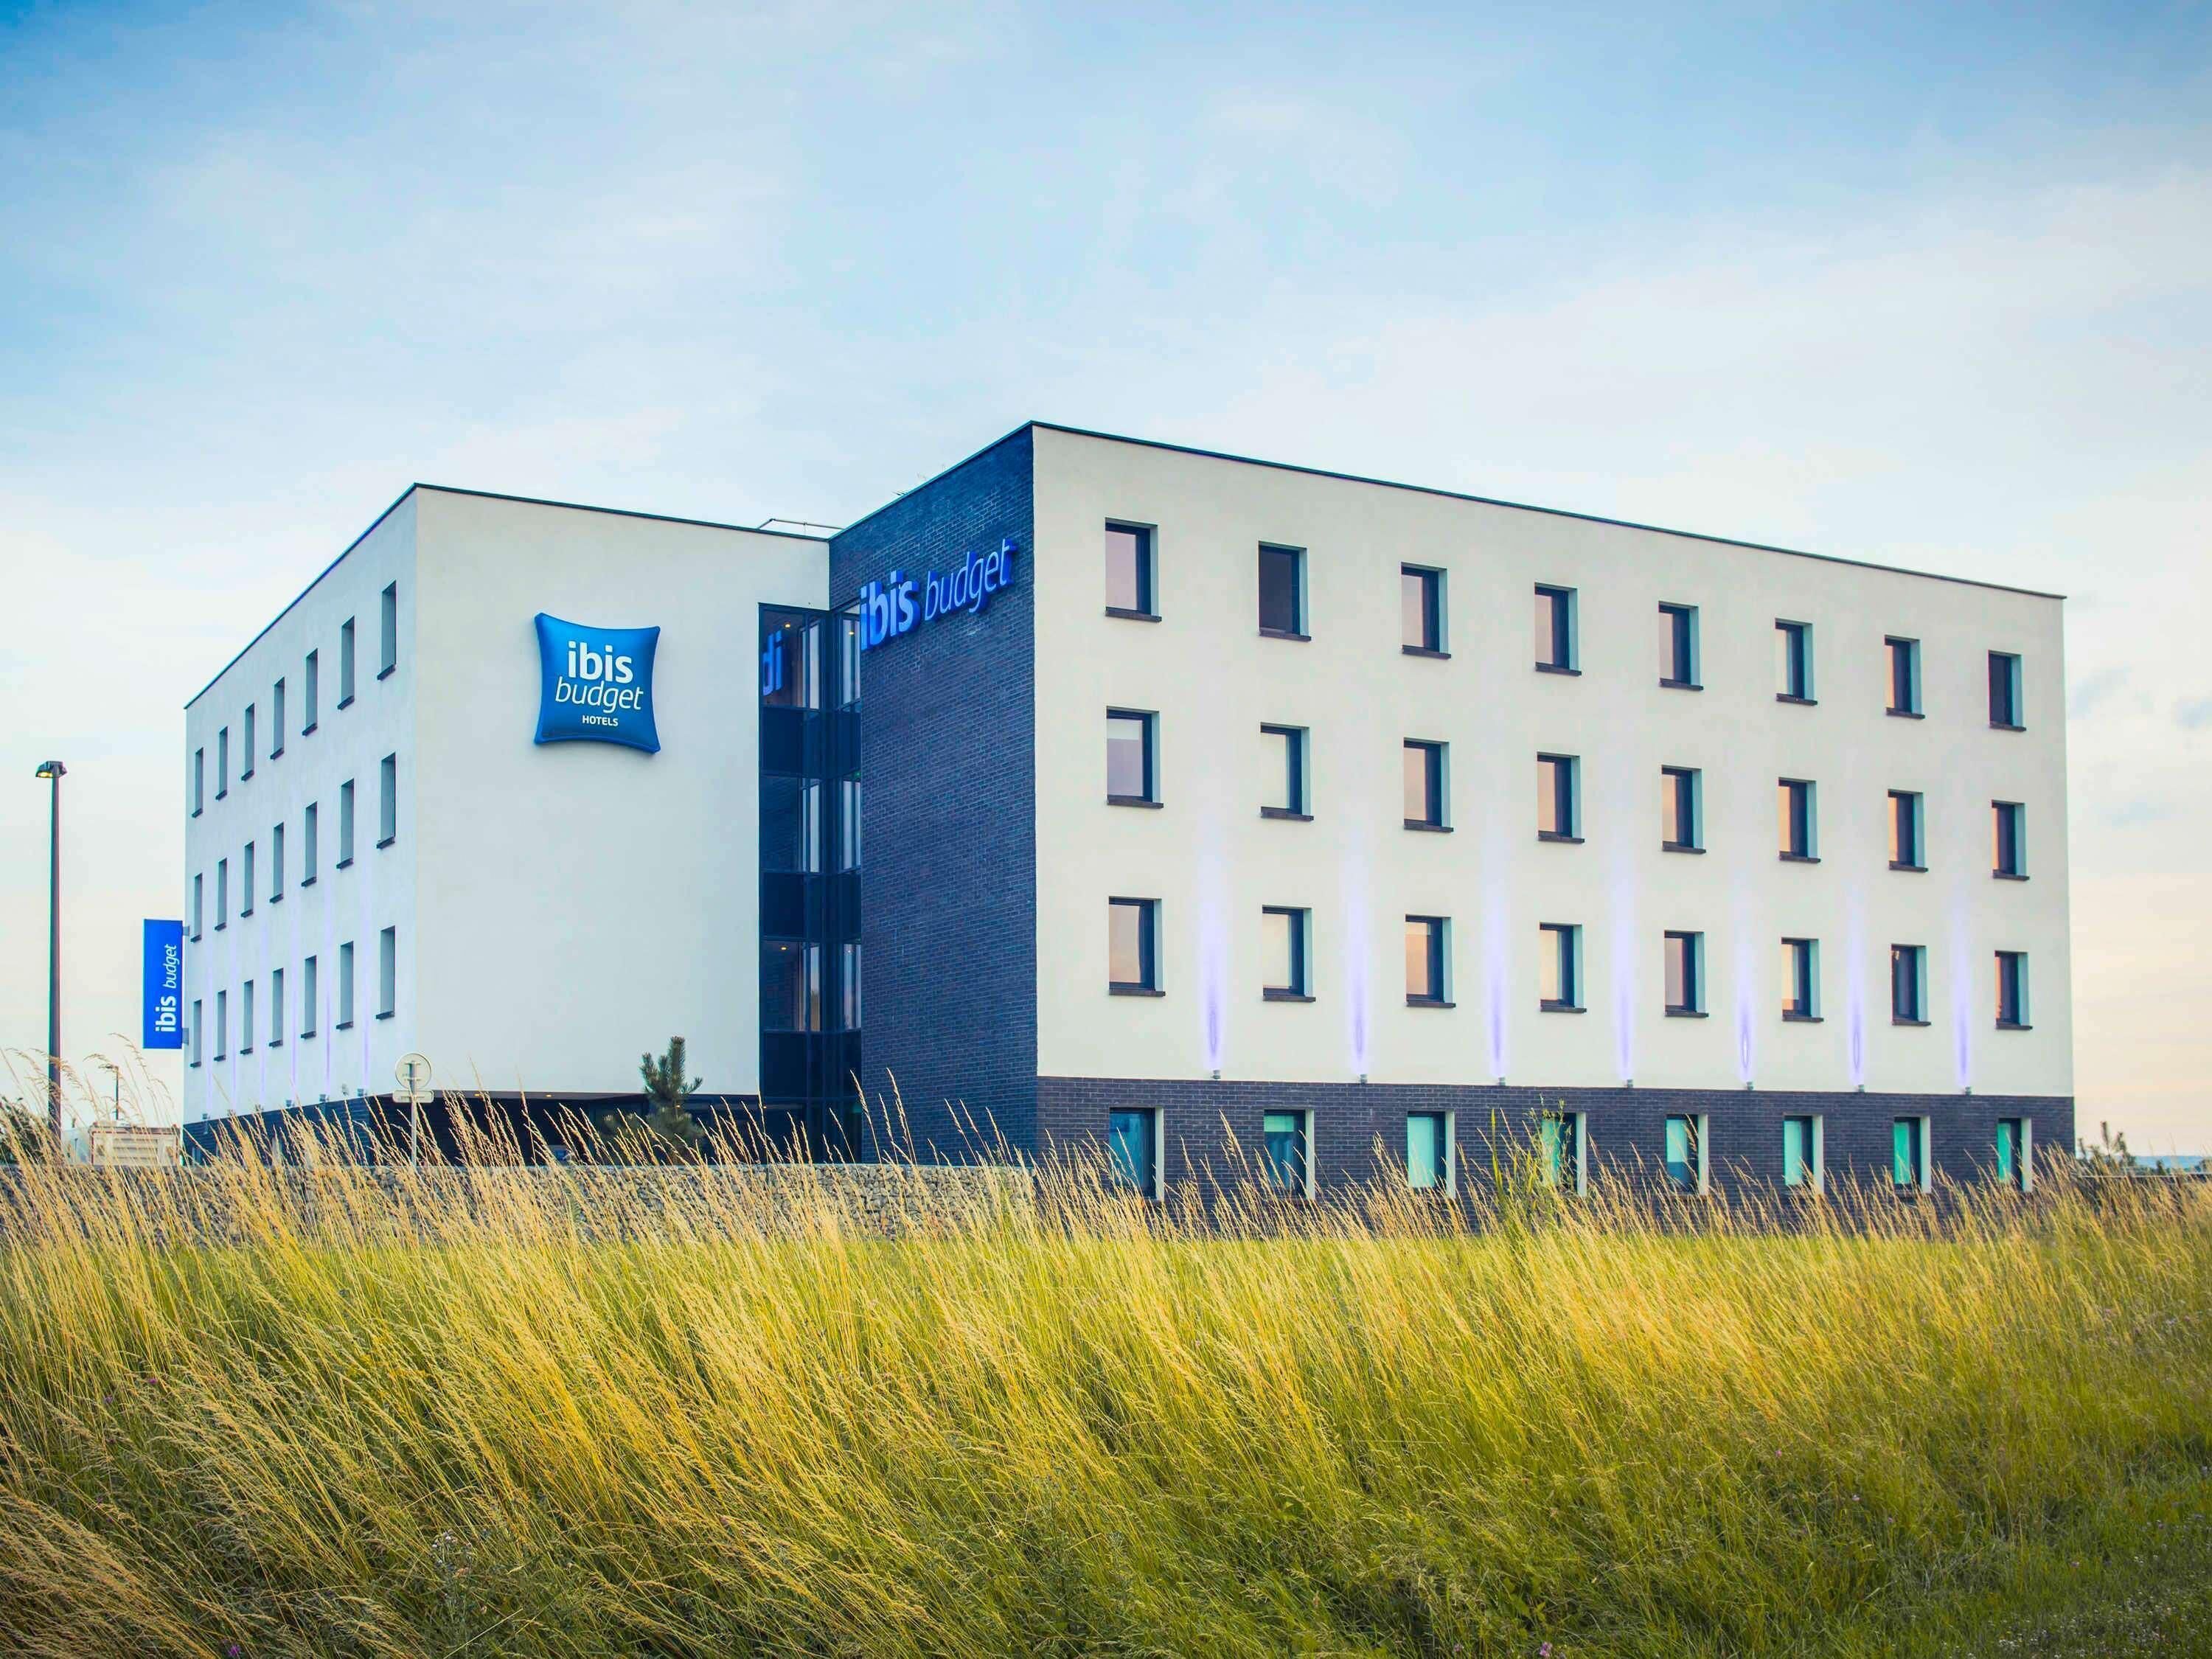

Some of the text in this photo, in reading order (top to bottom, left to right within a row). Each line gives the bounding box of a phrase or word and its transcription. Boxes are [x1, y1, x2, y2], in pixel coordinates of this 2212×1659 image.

[860, 538, 1016, 650] ibis budget
[568, 640, 633, 684] ibis
[555, 676, 644, 713] budget
[582, 715, 619, 726] HOTELS
[155, 944, 180, 1032] ibis budget
